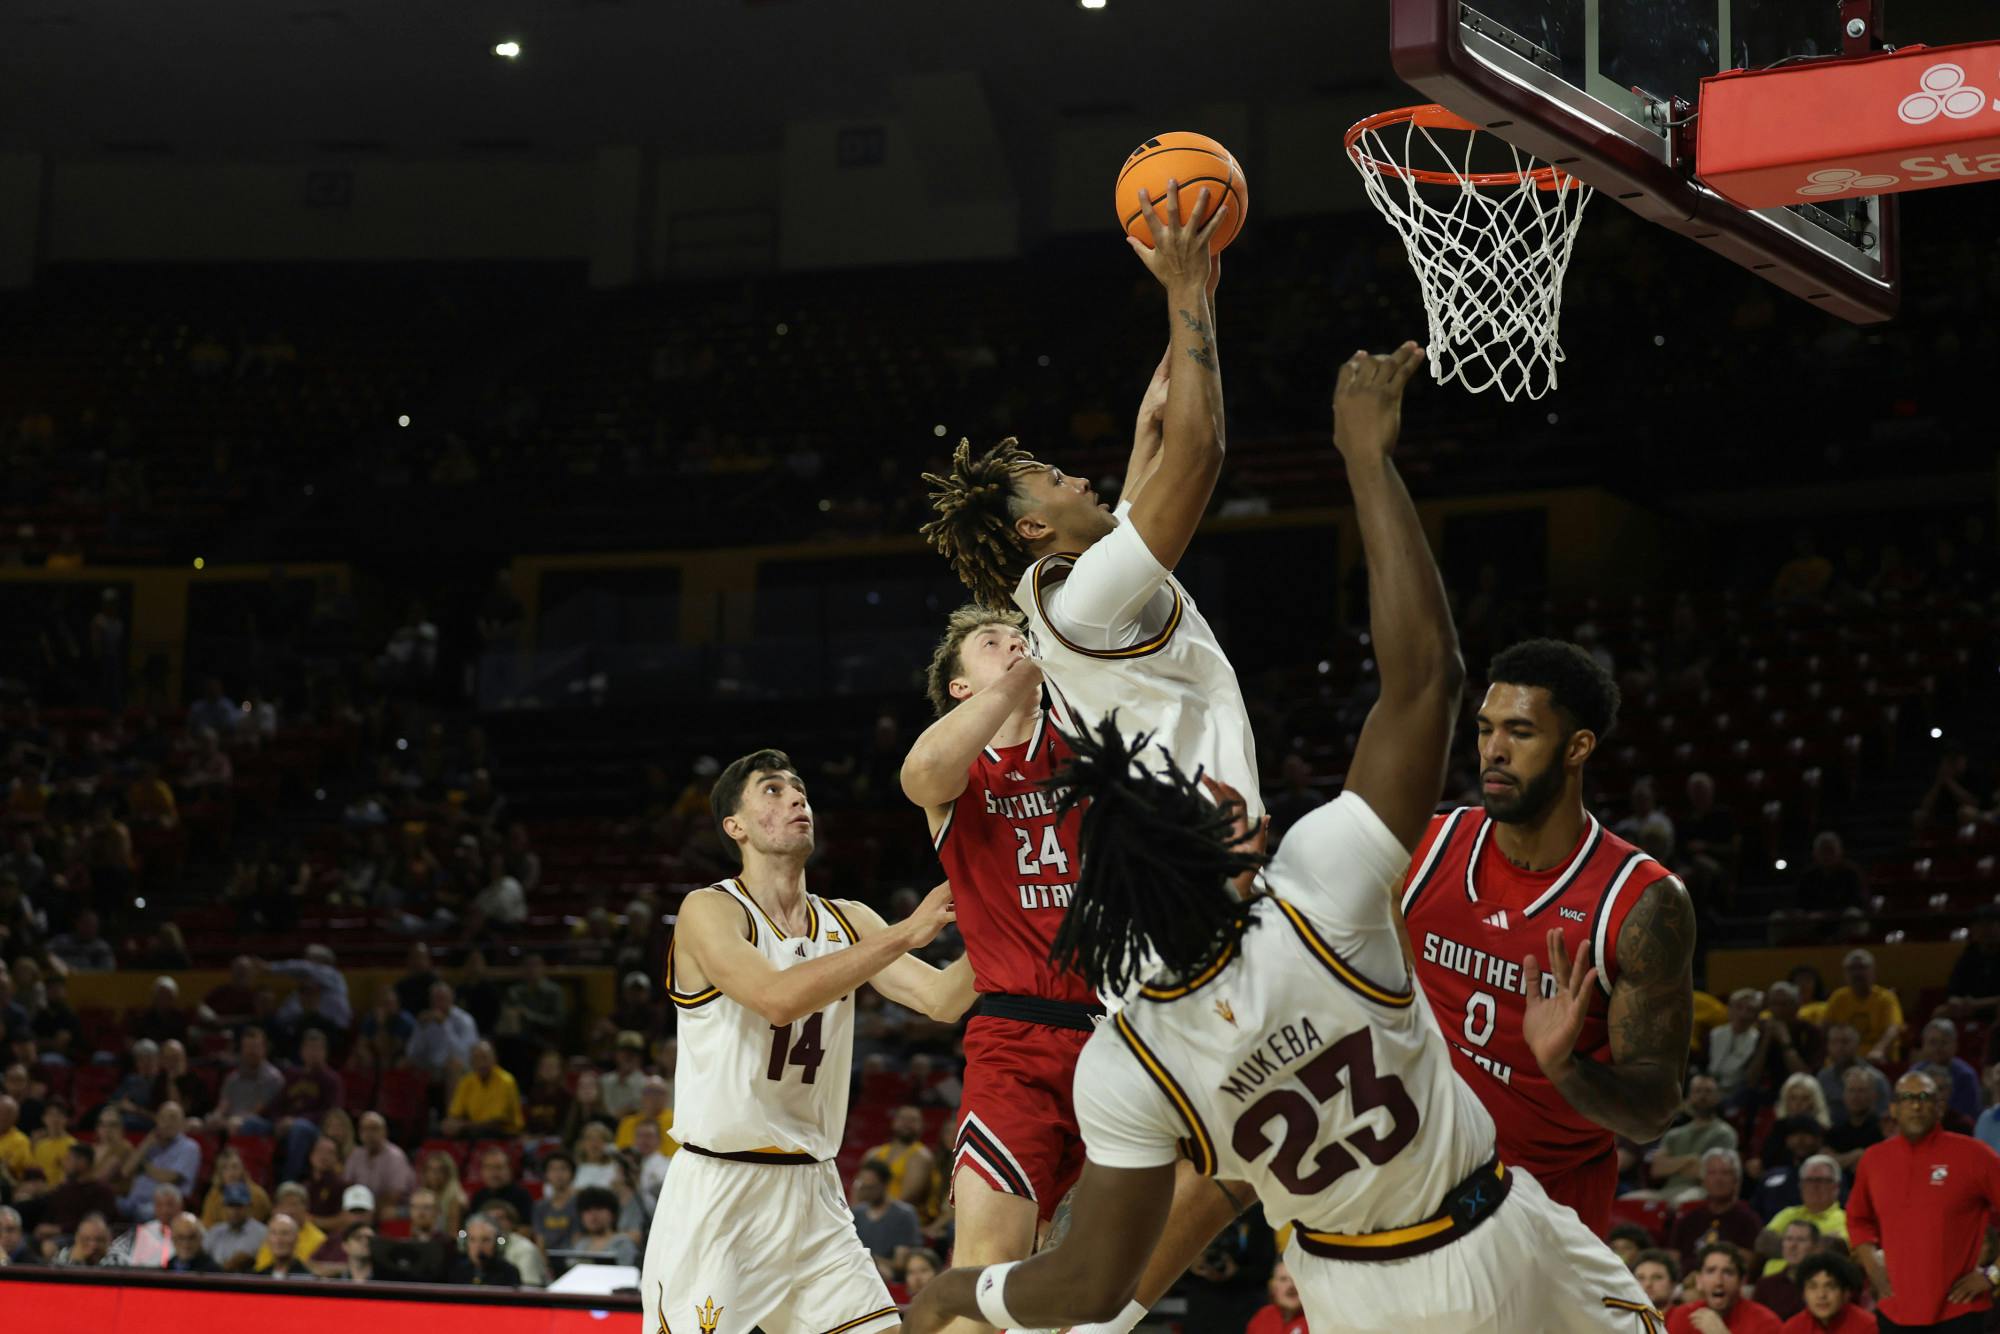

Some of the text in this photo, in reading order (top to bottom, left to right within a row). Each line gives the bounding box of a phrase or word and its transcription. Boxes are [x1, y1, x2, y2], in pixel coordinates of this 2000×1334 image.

[1015, 825, 1069, 875] 24
[1560, 906, 1586, 922] WAC
[767, 1012, 825, 1084] 14
[1464, 991, 1496, 1047] 0
[1220, 1017, 1323, 1102] MUKEBA
[1232, 1025, 1419, 1195] 23
